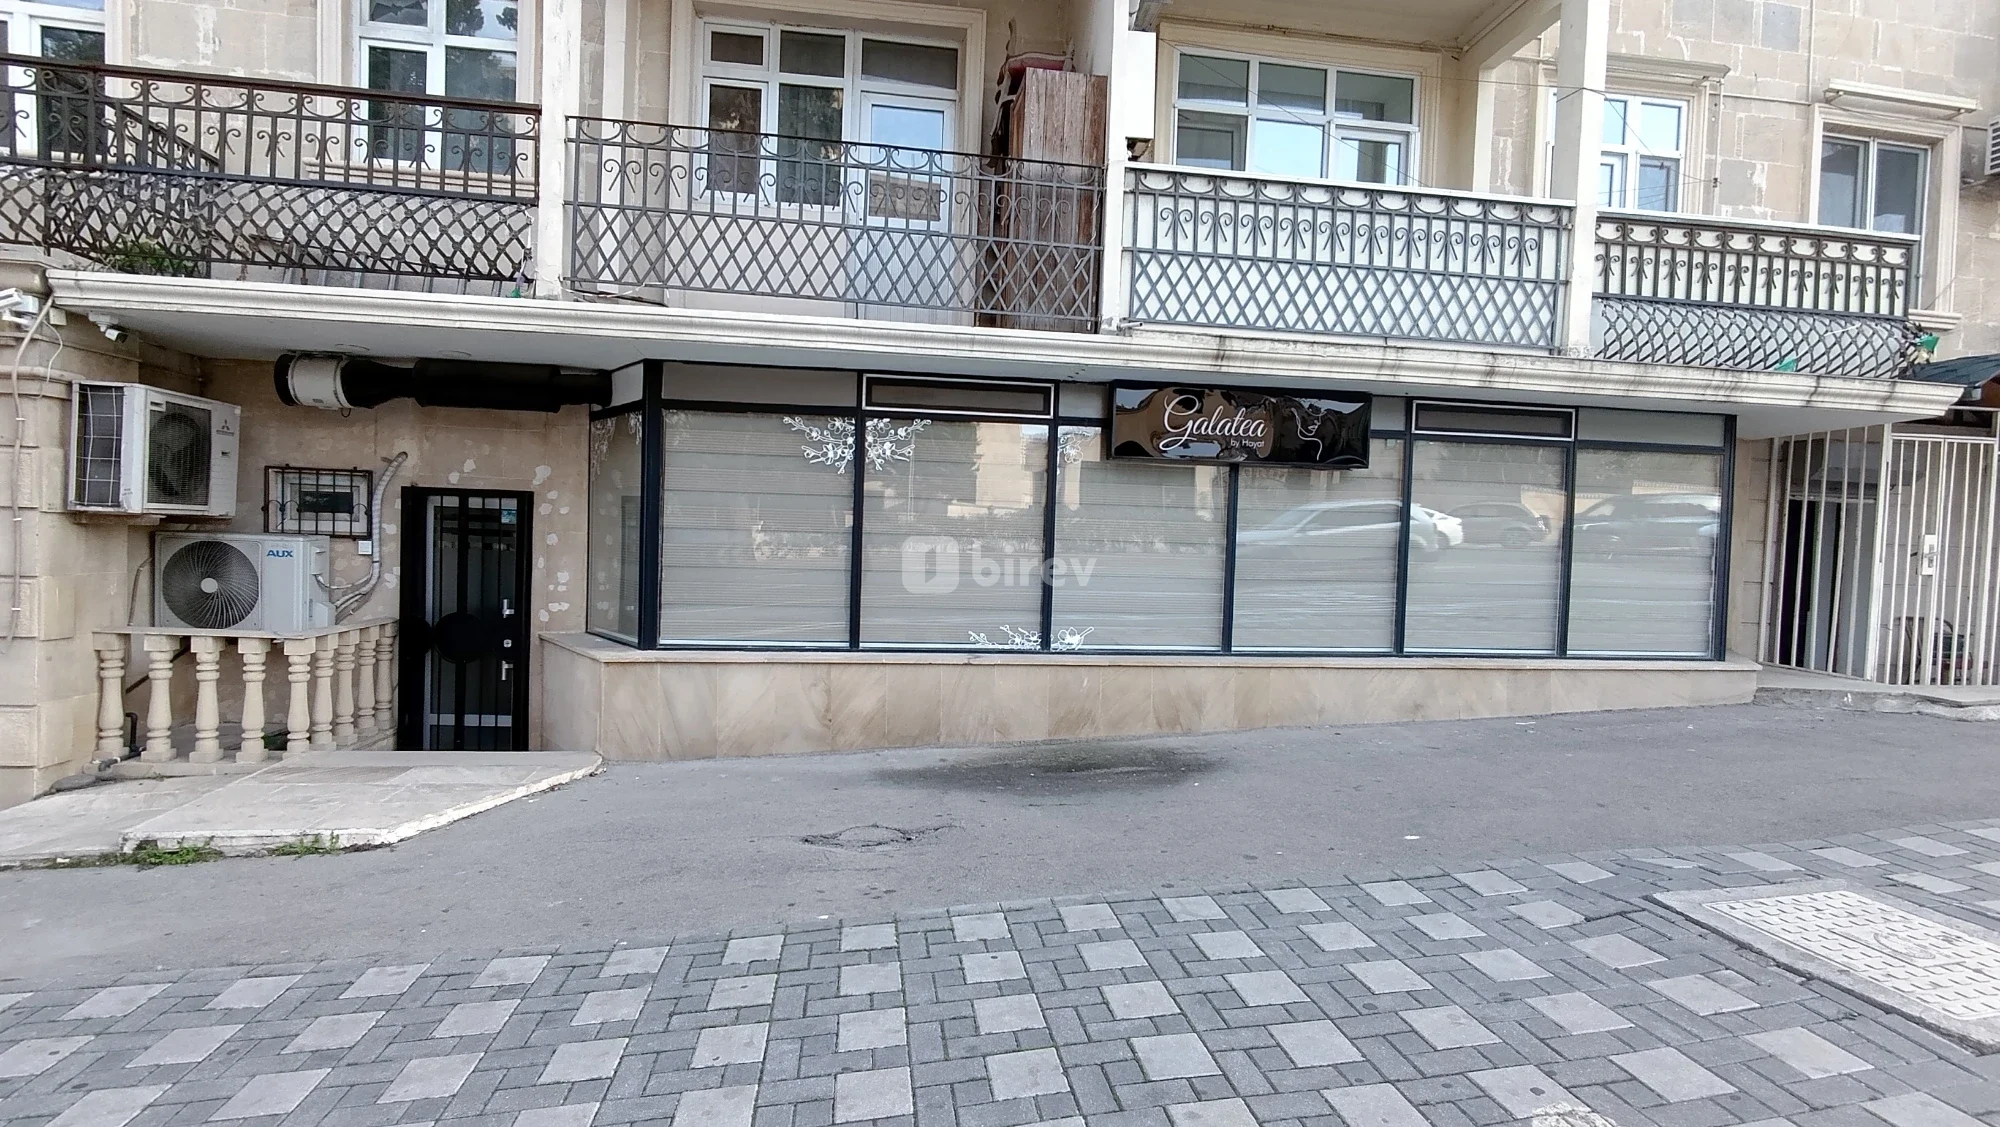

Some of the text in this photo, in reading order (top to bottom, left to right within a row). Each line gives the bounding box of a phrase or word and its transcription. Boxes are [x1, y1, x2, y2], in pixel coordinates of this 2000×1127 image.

[1159, 395, 1268, 450] Galatea
[1230, 438, 1265, 449] by Hayat
[266, 549, 294, 558] AUX
